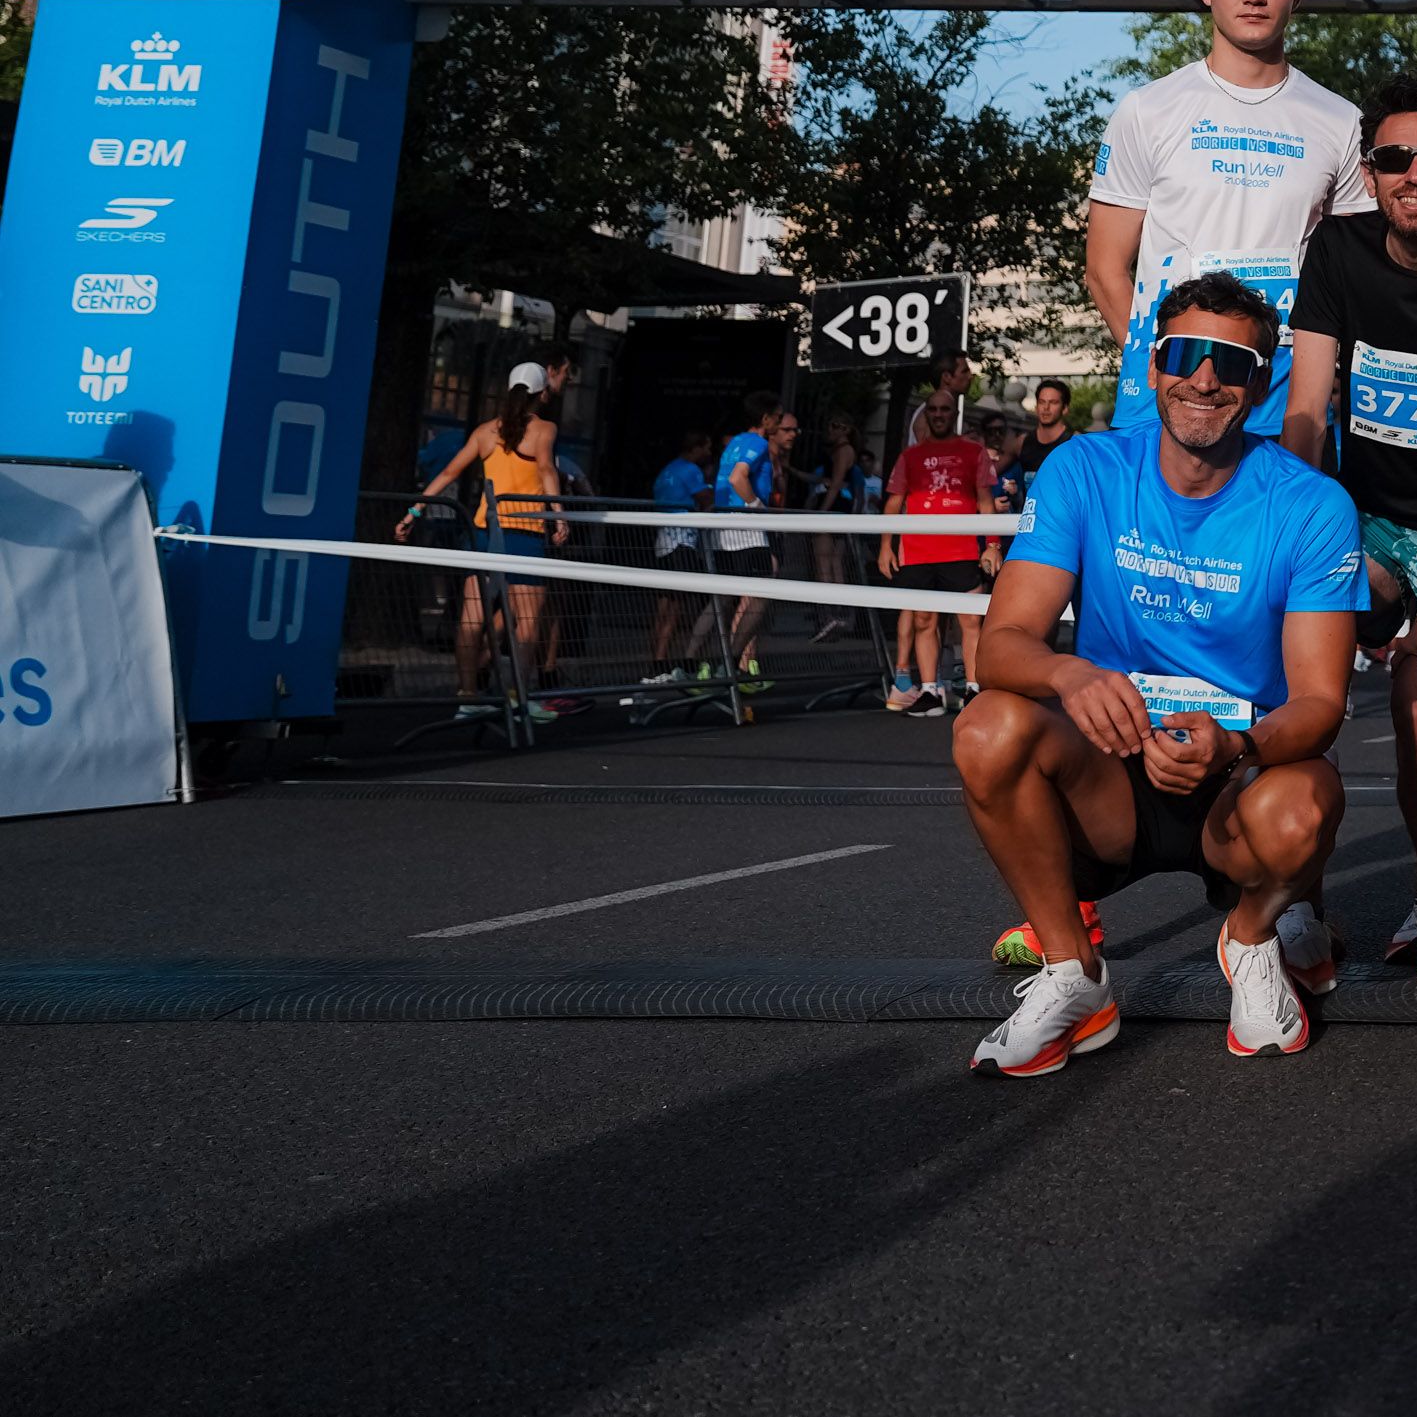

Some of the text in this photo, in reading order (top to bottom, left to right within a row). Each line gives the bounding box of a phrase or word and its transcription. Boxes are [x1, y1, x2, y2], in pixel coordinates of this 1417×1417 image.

[98, 64, 202, 93] KLM
[95, 95, 197, 107] Royal Dutch Airlines
[1224, 126, 1246, 134] Royal
[1247, 128, 1272, 137] Dutch
[1274, 132, 1304, 143] Airlines
[124, 139, 186, 166] BM
[1192, 137, 1304, 158] NORTE VS SUR
[1212, 160, 1284, 177] Run Well
[76, 231, 166, 243] SKECHERS
[80, 278, 124, 294] SANI
[77, 294, 152, 311] CENTRO
[247, 44, 371, 645] SOUTH
[1360, 363, 1397, 380] NORTE
[1385, 360, 1404, 368] Royal
[67, 411, 133, 425] TOTEEMI
[1203, 558, 1242, 570] Airlines
[1207, 572, 1240, 593] SUR
[1131, 585, 1170, 607] Run
[1159, 687, 1207, 697] Royal Dutch
[1212, 702, 1238, 716] SUR
